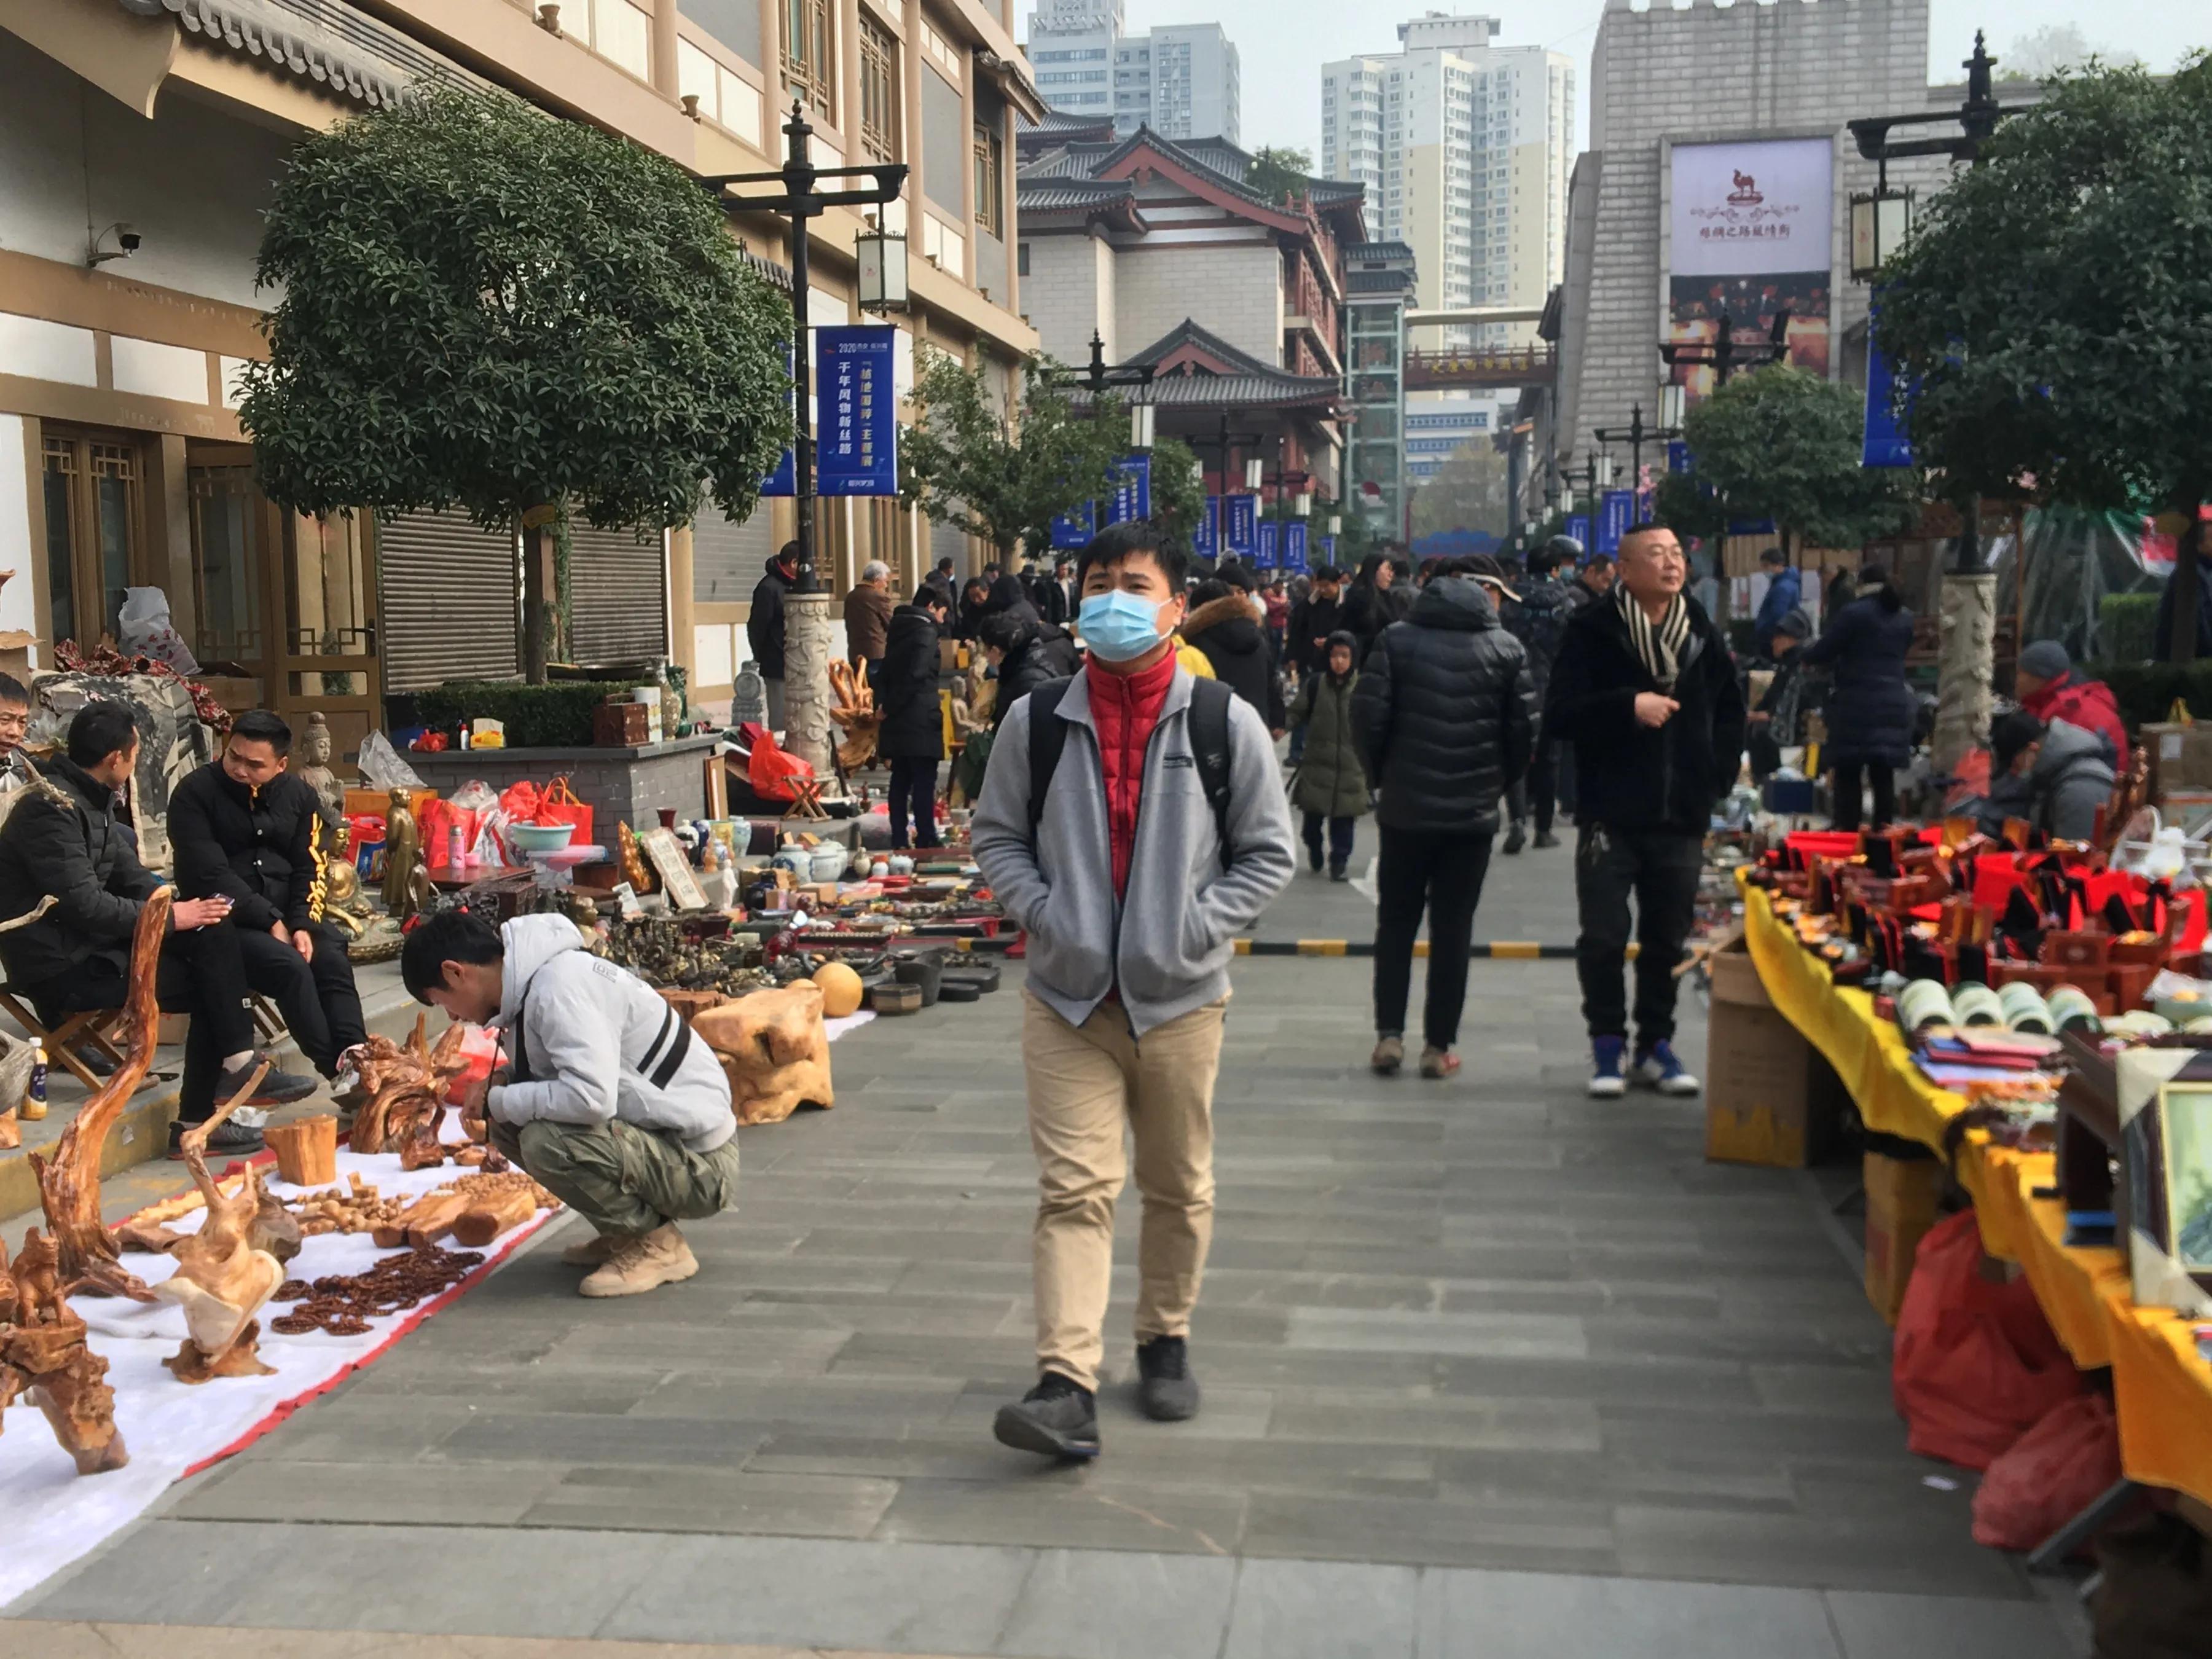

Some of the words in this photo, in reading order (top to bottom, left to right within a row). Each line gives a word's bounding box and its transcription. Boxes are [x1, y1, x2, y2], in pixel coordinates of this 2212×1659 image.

[838, 361, 852, 454] 千年风物新丝路
